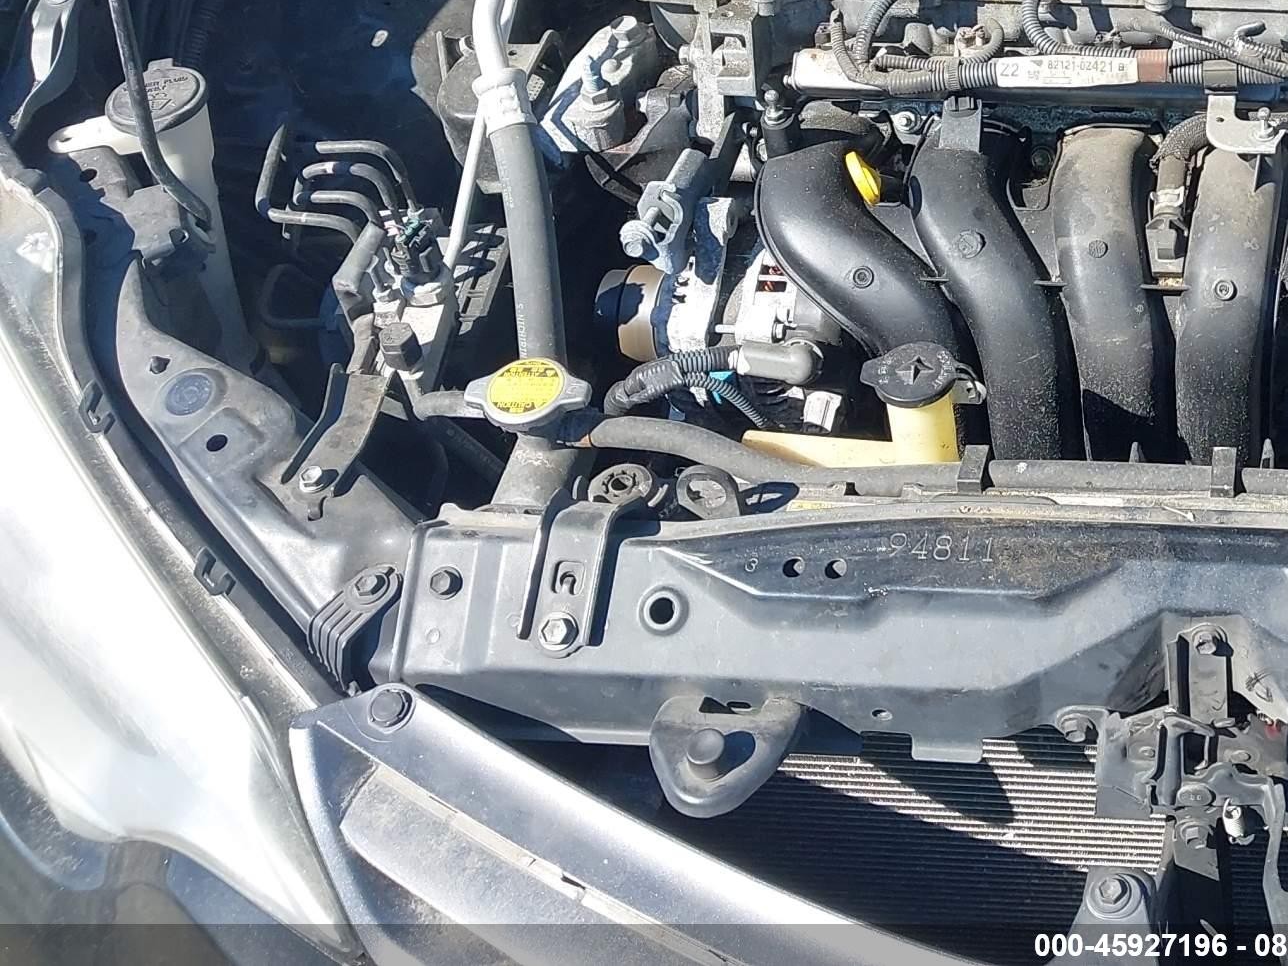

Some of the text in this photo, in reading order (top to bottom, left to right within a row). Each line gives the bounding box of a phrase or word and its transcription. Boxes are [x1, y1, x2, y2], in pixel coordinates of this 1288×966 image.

[1000, 62, 1019, 77] Z2
[1047, 59, 1113, 73] 82121-0Z421
[497, 401, 532, 409] CAUTION
[888, 530, 994, 562] 94811
